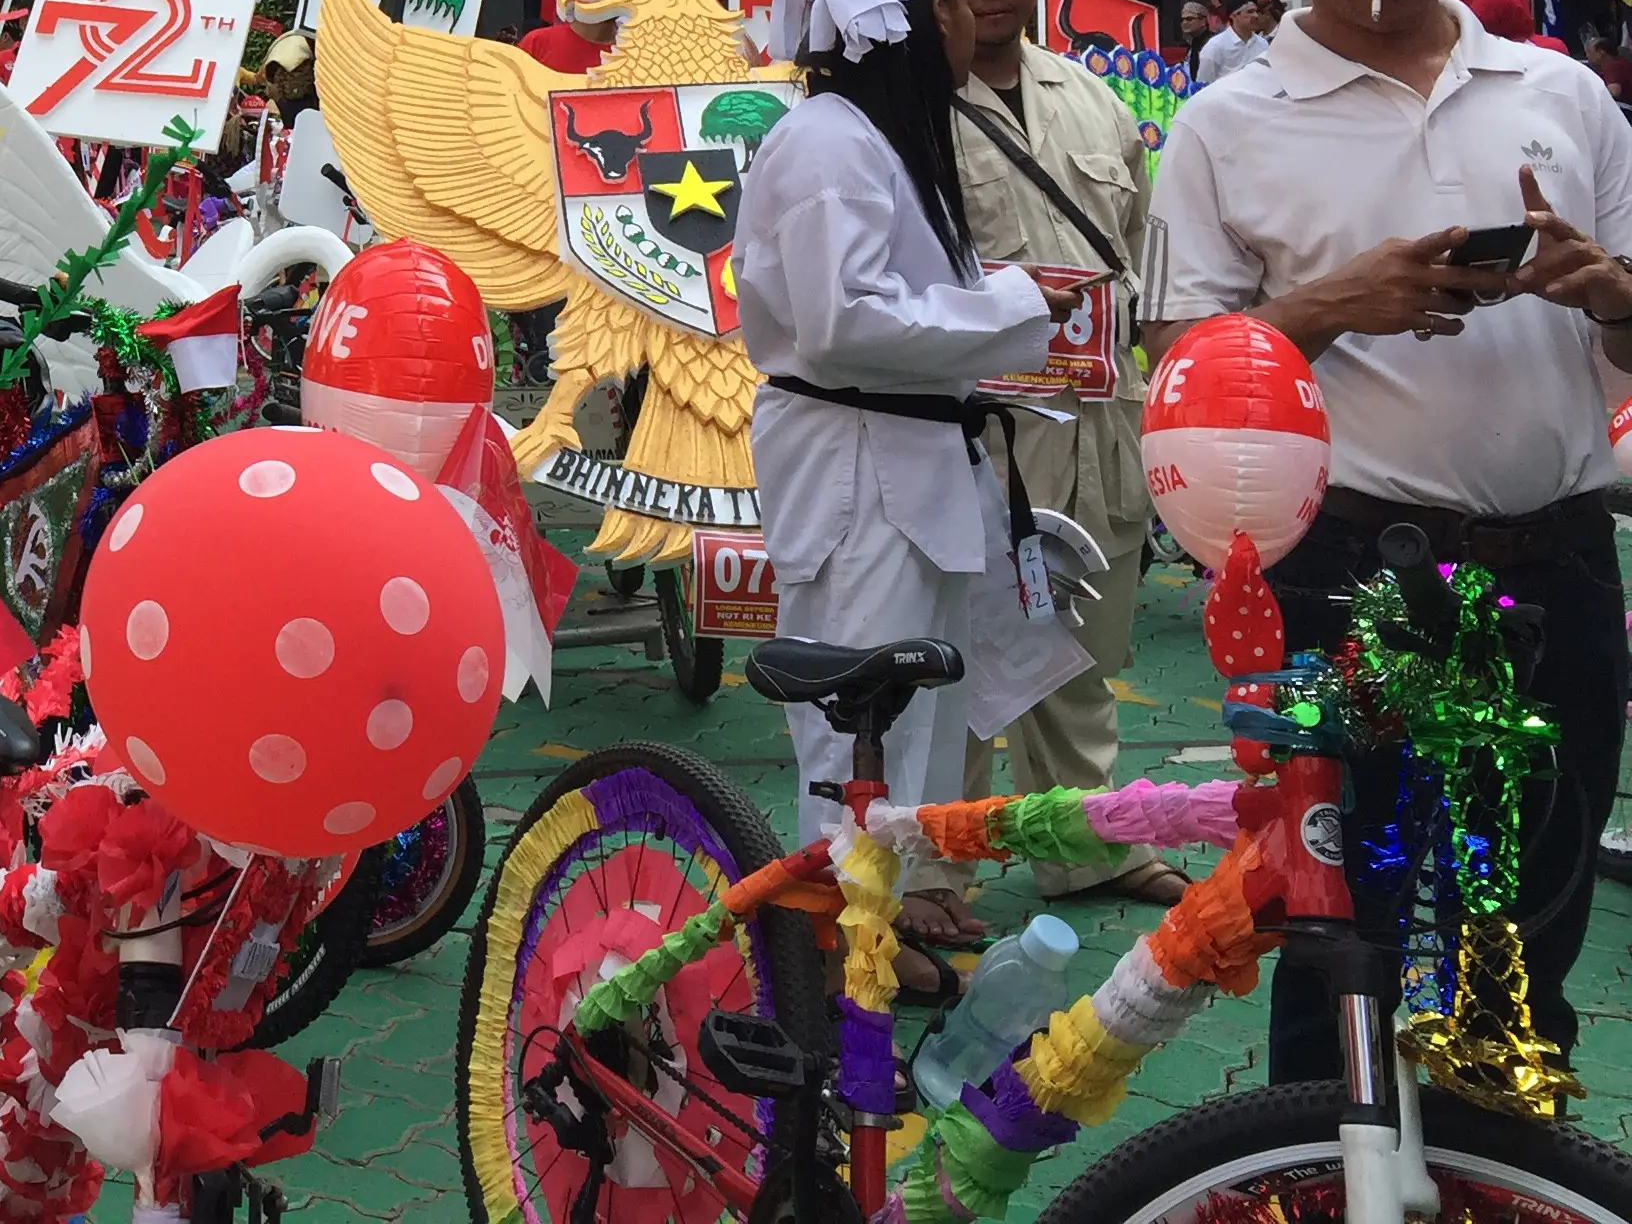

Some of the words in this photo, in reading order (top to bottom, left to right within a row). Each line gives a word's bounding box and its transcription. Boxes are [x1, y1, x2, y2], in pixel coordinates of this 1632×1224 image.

[546, 447, 716, 521] BHINNEKA
[713, 546, 778, 595] 07
[893, 650, 927, 665] TRINX
[1283, 1166, 1319, 1181] The
